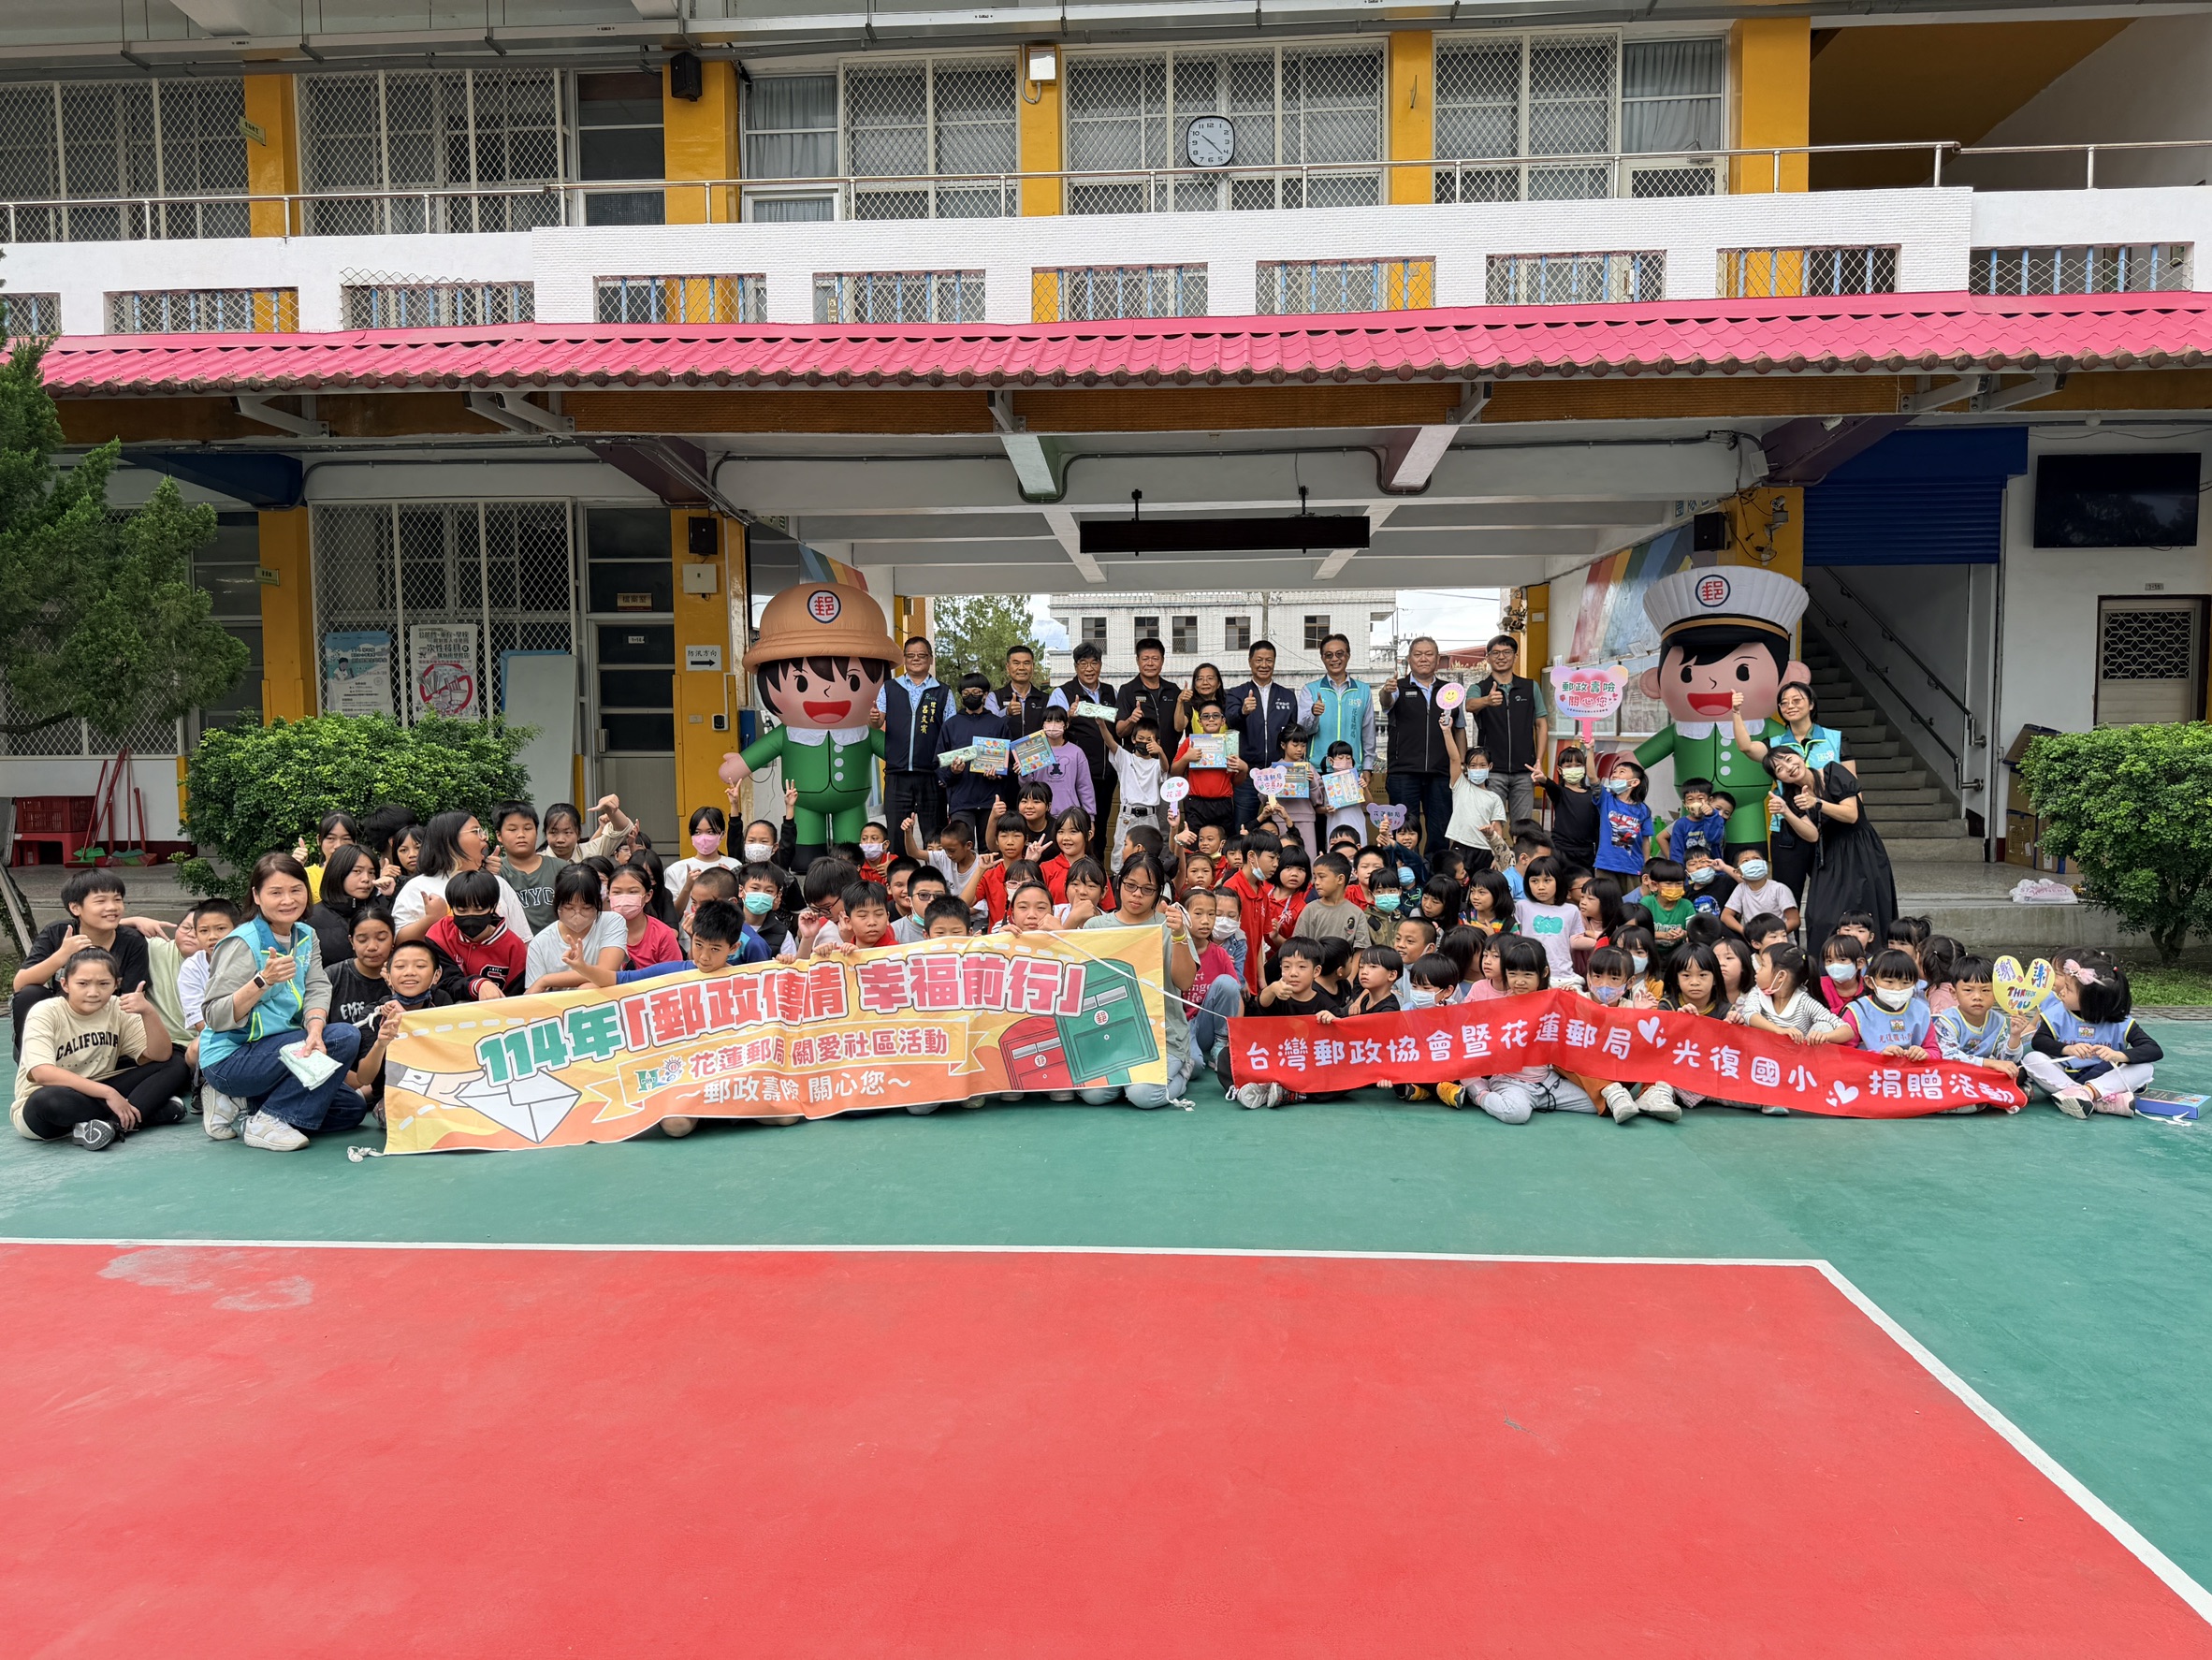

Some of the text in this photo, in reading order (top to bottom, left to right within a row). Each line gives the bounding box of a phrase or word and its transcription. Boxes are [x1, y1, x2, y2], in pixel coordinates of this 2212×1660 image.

[1702, 580, 1724, 601] 郵
[814, 596, 835, 617] 郵
[1562, 681, 1616, 693] 郵政壽險
[1568, 695, 1608, 707] 關心您
[517, 887, 555, 909] NYC
[860, 955, 1084, 1016] 幸福前行」
[2009, 1001, 2031, 1010] YOU
[56, 1031, 119, 1062] CALIFORNIA
[1245, 1012, 1632, 1072] 台灣郵政協會暨花蓮郵局
[690, 1028, 950, 1079] 花蓮郵局 關愛社區活動
[1672, 1039, 2016, 1104] 光復國小 捐贈活動
